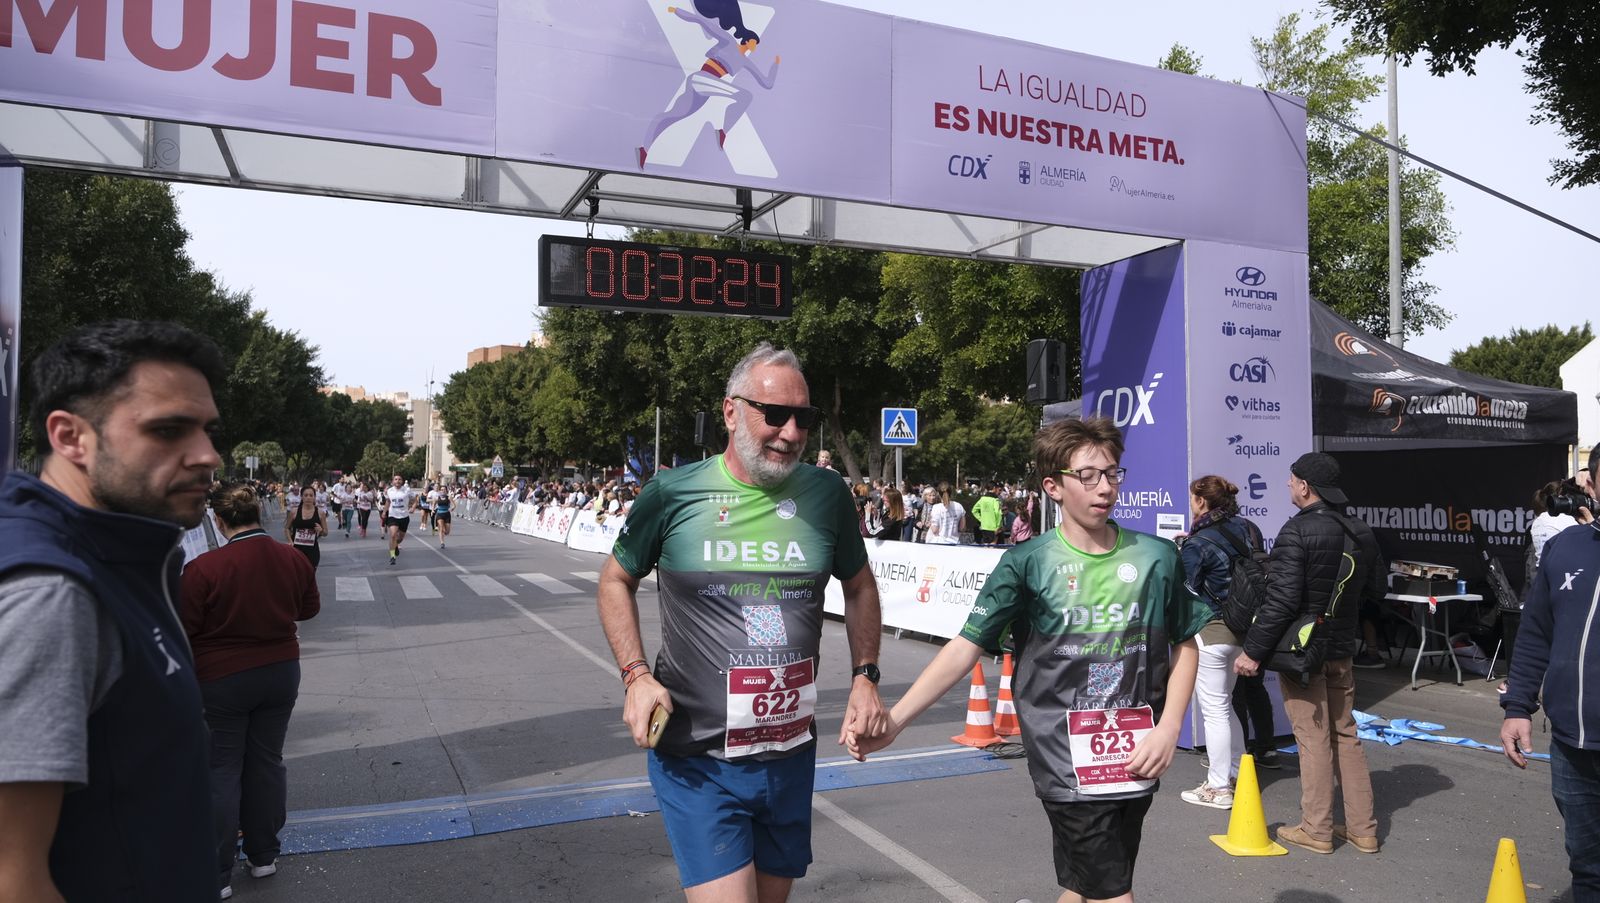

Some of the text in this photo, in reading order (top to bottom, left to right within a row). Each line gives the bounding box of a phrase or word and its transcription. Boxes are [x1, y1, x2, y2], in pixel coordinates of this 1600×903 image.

[0, 0, 442, 106] MUJER
[979, 65, 1147, 118] LA IGUALDAD
[934, 102, 1185, 165] ES NUESTRA META.
[948, 154, 993, 180] CDX
[1040, 165, 1087, 182] ALMERÍA
[1040, 177, 1065, 188] CIUDAD
[586, 246, 781, 307] 00:32:24
[1224, 287, 1278, 301] HYUNDAI
[1239, 324, 1282, 338] cajamar
[1242, 398, 1281, 412] vithas
[1235, 442, 1280, 459] aqualia
[1114, 488, 1173, 507] ALMERÍA
[1113, 508, 1142, 519] CIUDAD
[1239, 505, 1268, 517] Clece
[703, 540, 806, 562] IDESA
[942, 590, 973, 607] CIUDAD
[1062, 602, 1140, 626] IDESA
[752, 689, 801, 717] 622
[755, 712, 797, 724] MARANDRES
[1090, 731, 1136, 756] 623
